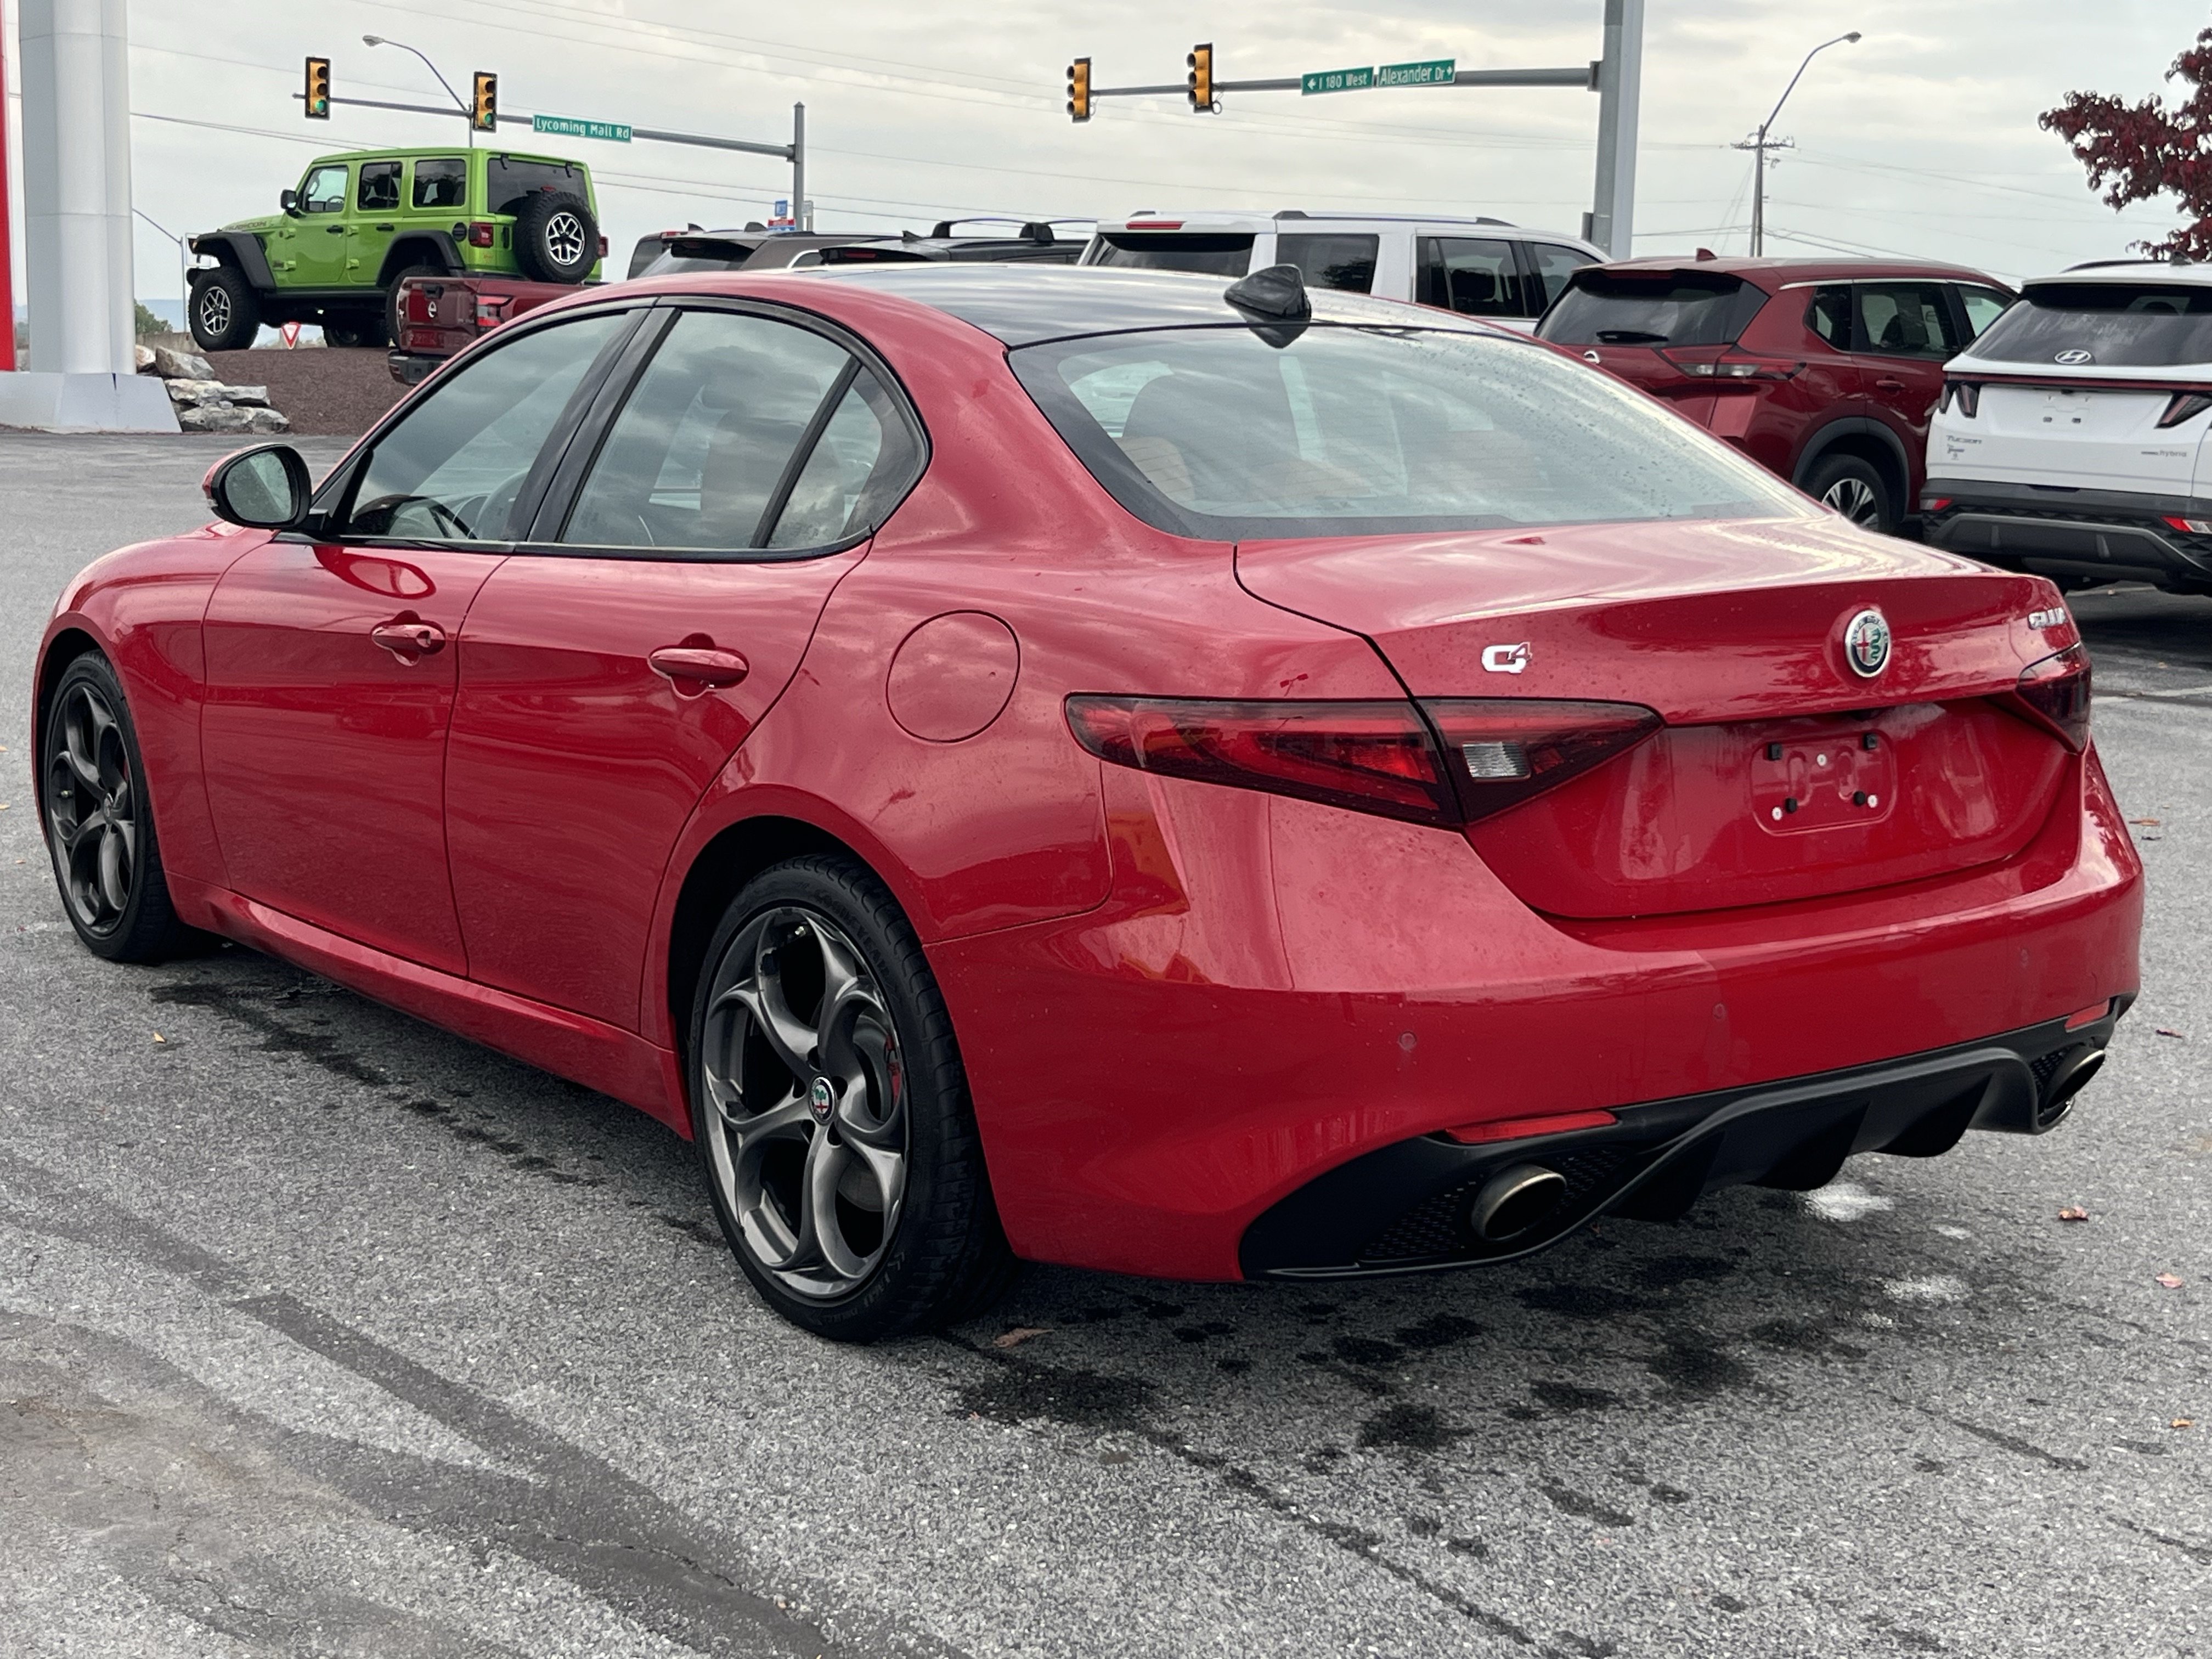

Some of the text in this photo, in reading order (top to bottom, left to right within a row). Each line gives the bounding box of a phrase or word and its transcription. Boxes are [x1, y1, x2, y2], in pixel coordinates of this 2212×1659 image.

[1319, 72, 1367, 89] I 180 West
[1379, 65, 1445, 85] Alexander Dr
[536, 117, 629, 139] Lycoming Mall Rd
